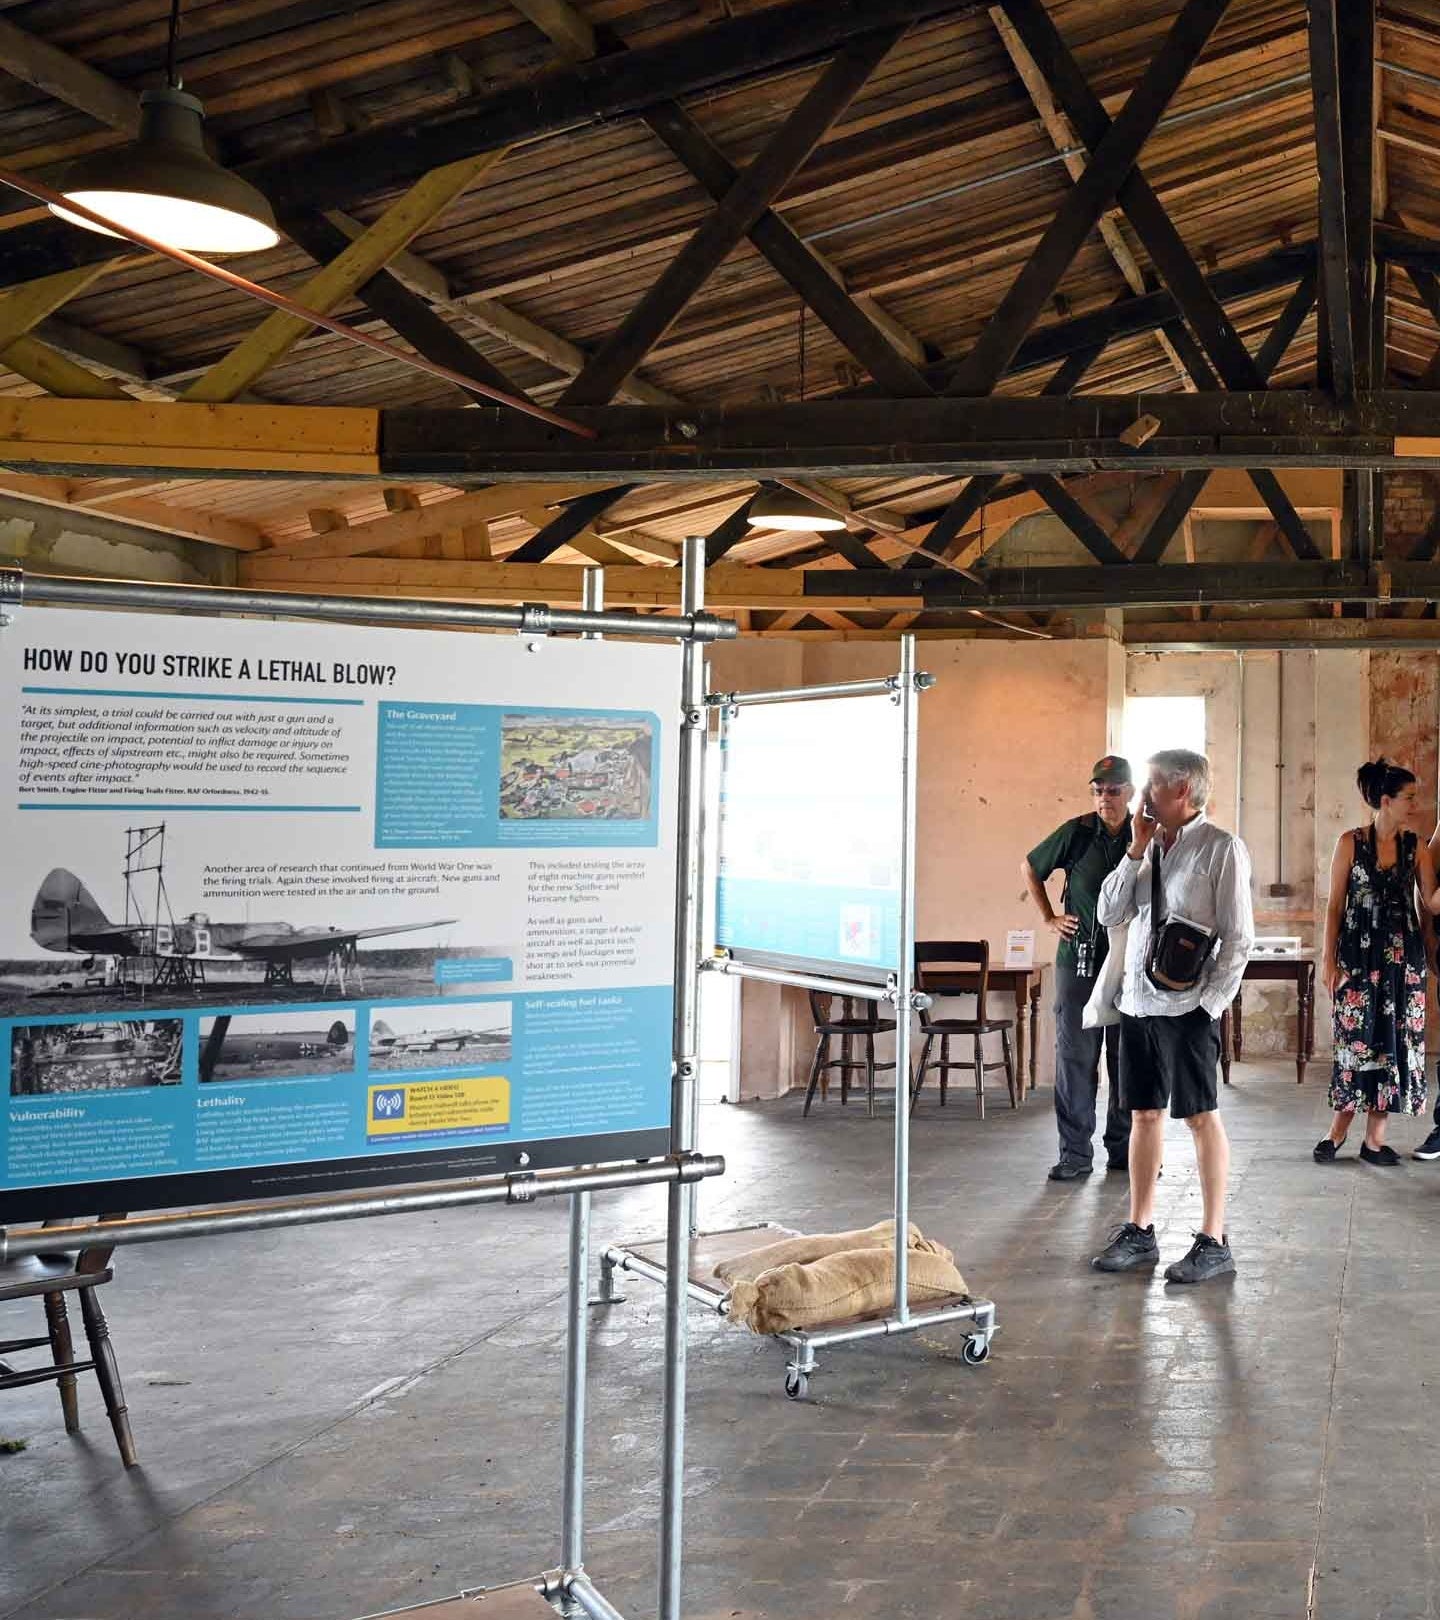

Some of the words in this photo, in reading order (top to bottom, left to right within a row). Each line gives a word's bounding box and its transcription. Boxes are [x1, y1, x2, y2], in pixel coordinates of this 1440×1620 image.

[23, 648, 72, 671] HOW
[80, 651, 108, 673] DO
[115, 652, 156, 675] YOU
[162, 655, 232, 679] STRIKE
[238, 659, 251, 680] A
[258, 660, 326, 683] LETHAL
[333, 663, 396, 685] BLOW?
[39, 706, 51, 715] its
[54, 706, 99, 720] simplest,
[111, 708, 132, 718] trial
[135, 709, 163, 719] could
[165, 710, 177, 719] be
[180, 710, 214, 720] carried
[216, 711, 232, 720] out
[235, 712, 255, 721] with
[257, 712, 275, 725] just
[286, 716, 304, 726] gun
[306, 714, 325, 723] and
[387, 710, 405, 719] The
[407, 710, 457, 722] Graveyard
[21, 719, 54, 732] target,
[57, 720, 75, 729] but
[78, 720, 131, 731] additional
[134, 722, 194, 736] information
[197, 724, 219, 733] such
[235, 725, 270, 738] velocity
[272, 726, 291, 735] and
[293, 726, 328, 736] altitude
[331, 727, 340, 740] of
[20, 732, 37, 741] the
[39, 732, 88, 745] projectile
[106, 734, 144, 747] impact,
[147, 735, 193, 748] potential
[195, 736, 205, 745] to
[208, 736, 234, 749] inflict
[238, 737, 277, 750] damage
[292, 738, 318, 751] injury
[20, 745, 59, 758] impact,
[62, 746, 94, 759] effects
[98, 747, 108, 759] of
[111, 747, 162, 760] slipstream
[188, 749, 216, 761] might
[219, 749, 239, 759] also
[242, 750, 254, 759] be
[256, 750, 295, 763] required.
[299, 751, 348, 761] Sometimes
[19, 759, 77, 772] high-speed
[80, 760, 170, 773] cine-photography
[172, 762, 202, 771] would
[205, 762, 217, 771] be
[219, 762, 241, 772] used
[244, 763, 254, 772] to
[256, 763, 286, 772] record
[288, 763, 303, 773] the
[306, 766, 346, 776] sequence
[18, 772, 30, 784] of
[32, 772, 65, 782] events
[68, 773, 92, 785] after
[203, 865, 242, 873] Another
[267, 864, 276, 872] of
[279, 864, 317, 872] research
[319, 864, 337, 872] that
[340, 863, 385, 872] continued
[387, 863, 408, 871] from
[410, 863, 436, 871] World
[438, 863, 454, 871] War
[203, 877, 219, 885] the
[221, 877, 246, 887] firing
[276, 876, 302, 886] Again
[304, 876, 329, 884] these
[332, 875, 368, 884] involved
[371, 875, 393, 885] firing
[396, 875, 404, 883] at
[484, 874, 499, 882] and
[202, 889, 260, 898] ammunition
[287, 888, 315, 896] tested
[318, 888, 326, 896] in
[328, 888, 343, 896] the
[346, 888, 356, 896] air
[359, 887, 375, 896] and
[391, 887, 404, 895] the
[197, 1095, 247, 1107] Lethality
[9, 1107, 86, 1122] Vulnerability
